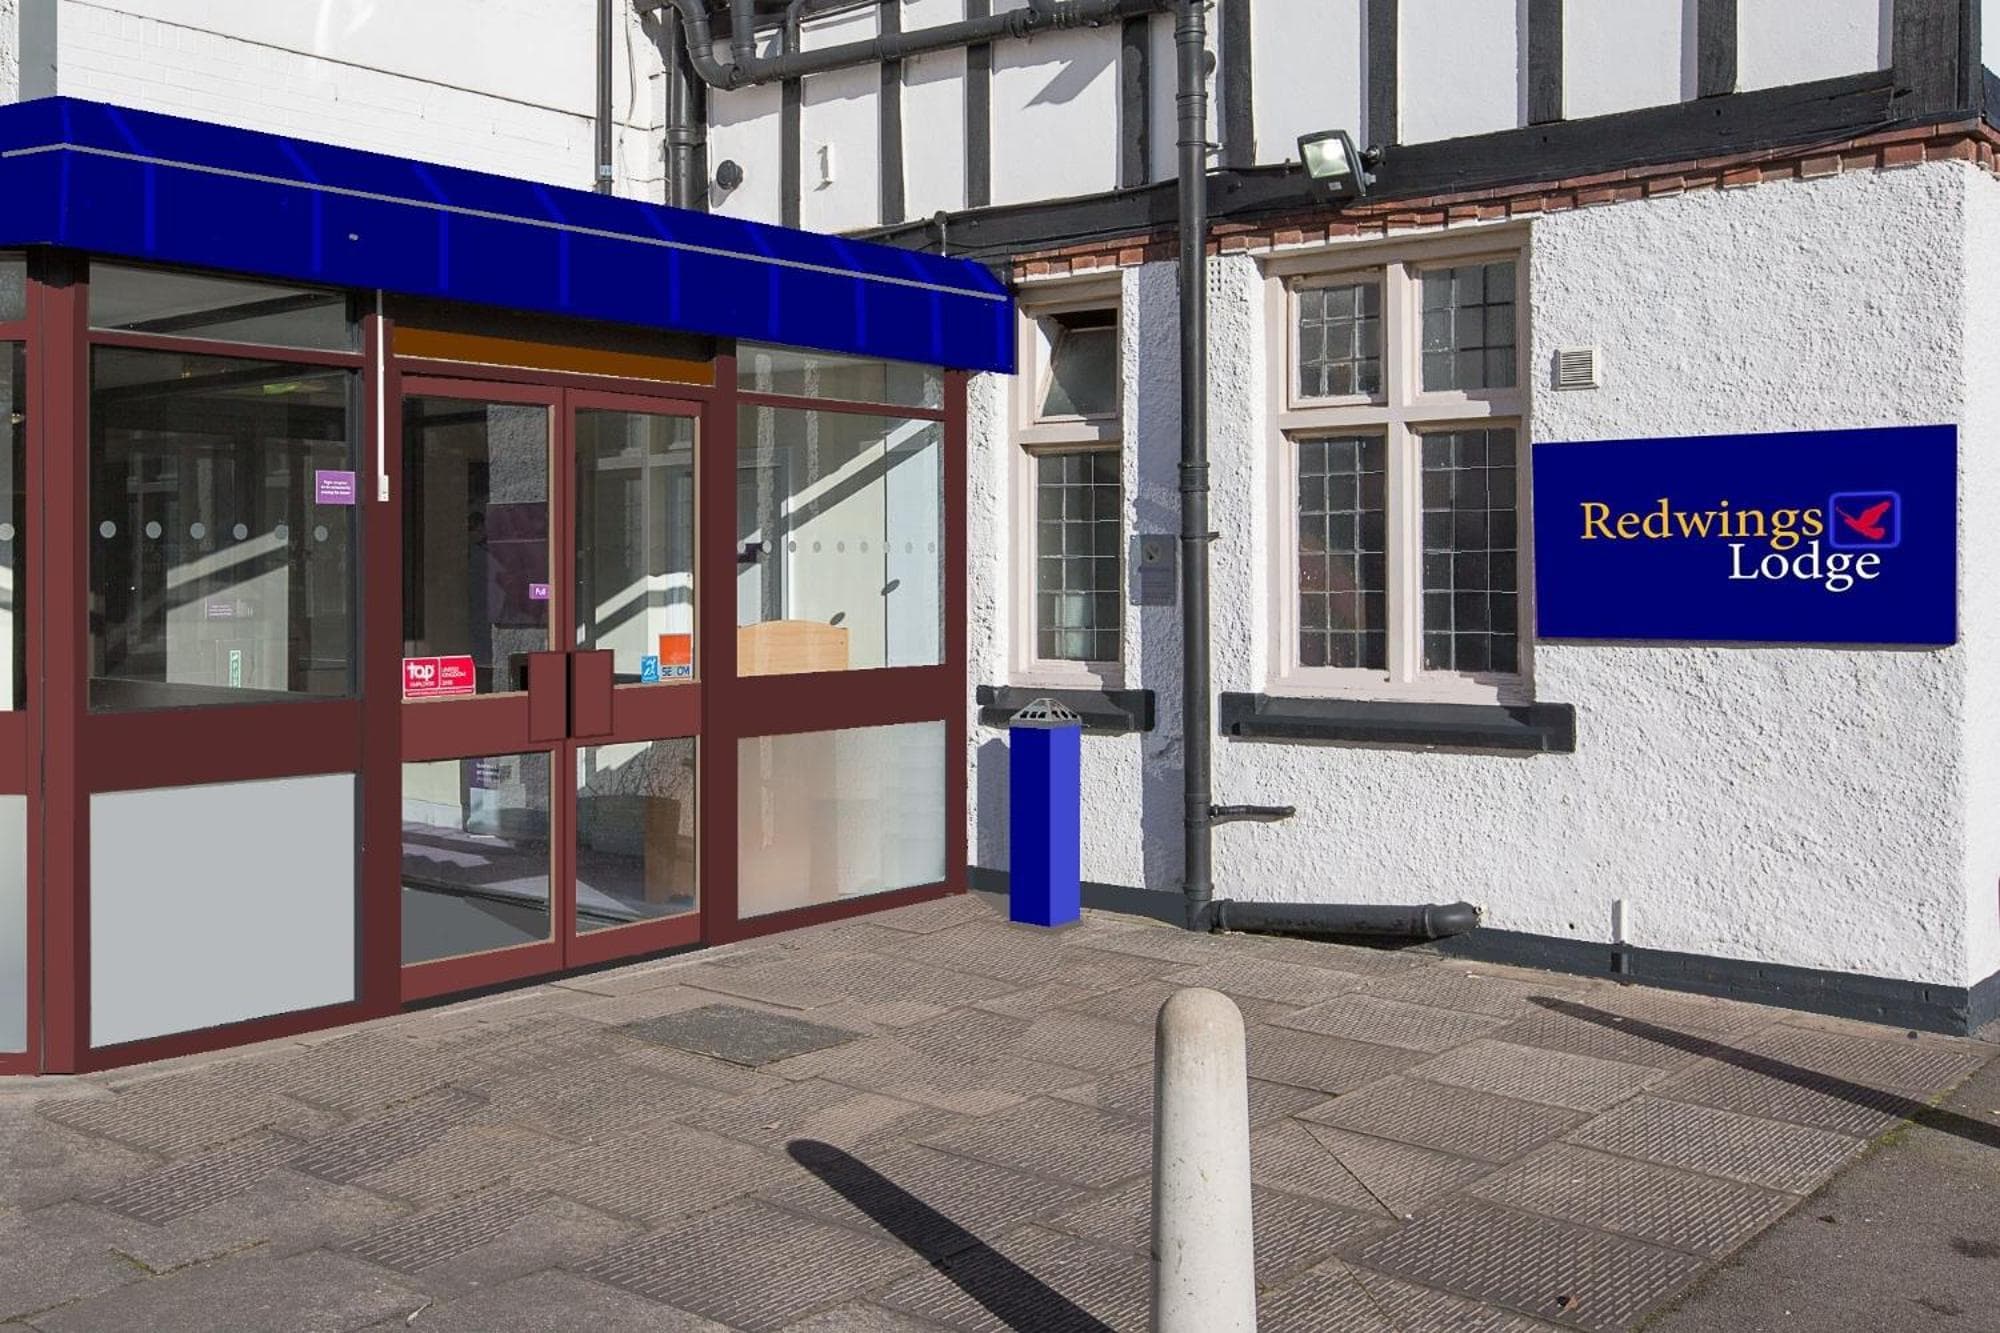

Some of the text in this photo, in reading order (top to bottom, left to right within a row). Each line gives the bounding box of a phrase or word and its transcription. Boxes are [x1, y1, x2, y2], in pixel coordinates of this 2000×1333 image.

[1580, 497, 1824, 551] Redwings
[1728, 540, 1882, 592] Lodge
[406, 662, 434, 681] top
